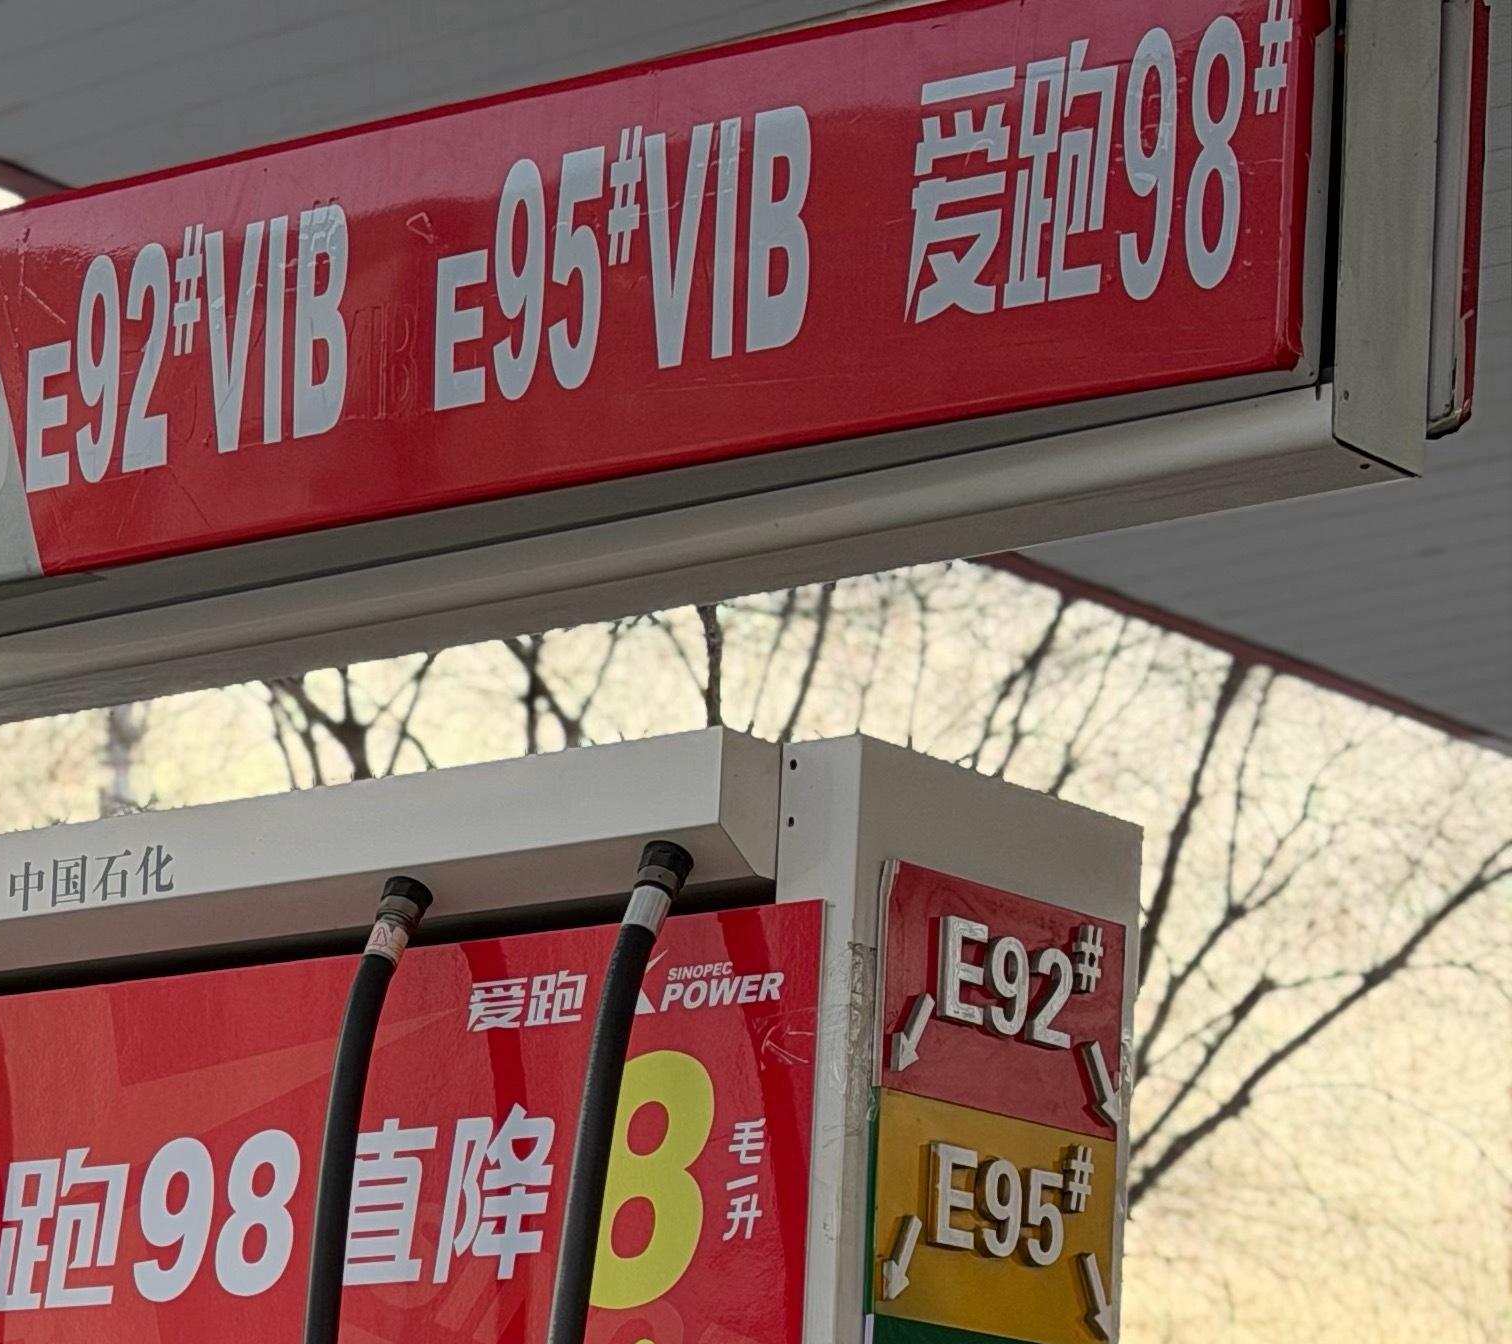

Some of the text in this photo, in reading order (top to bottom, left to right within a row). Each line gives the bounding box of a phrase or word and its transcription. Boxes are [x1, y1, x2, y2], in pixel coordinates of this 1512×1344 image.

[9, 844, 175, 912] 中国石化
[659, 972, 785, 1012] POWER
[668, 963, 732, 981] SINOPEC
[467, 976, 585, 1032] 爱跑
